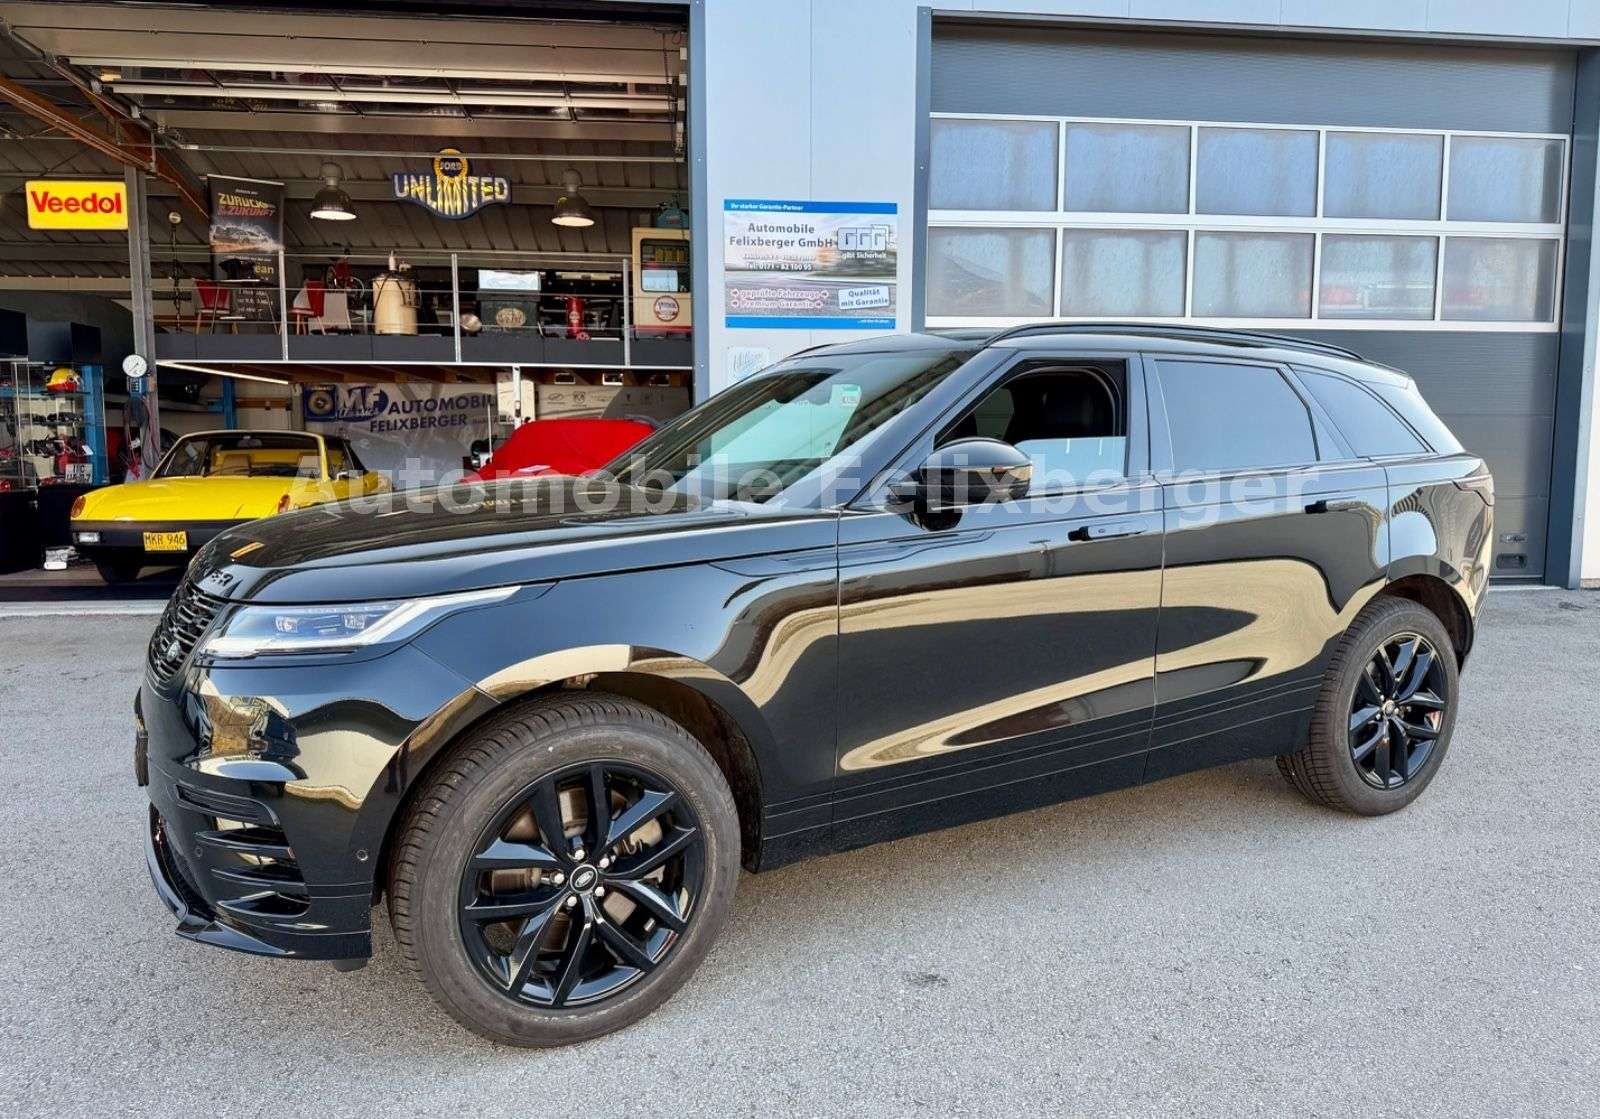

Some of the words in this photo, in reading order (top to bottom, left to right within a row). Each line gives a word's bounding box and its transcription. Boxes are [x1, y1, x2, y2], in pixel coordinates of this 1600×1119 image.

[394, 174, 508, 216] UNLIMITED
[31, 191, 121, 213] Veedol
[748, 223, 815, 234] Automobile
[730, 236, 794, 249] Felixberger
[798, 238, 833, 248] GmbH
[857, 251, 887, 259] Sicherheit
[778, 288, 820, 299] Fahrzeuge
[848, 288, 880, 298] Qualität
[741, 299, 778, 307] Premium
[780, 300, 813, 308] Garantie
[841, 299, 853, 307] mit
[855, 297, 888, 306] Garantie
[388, 393, 497, 415] AUTOMOBIL
[370, 413, 468, 433] FELIXBERGER
[145, 533, 163, 545] MKR
[167, 533, 185, 545] 946
